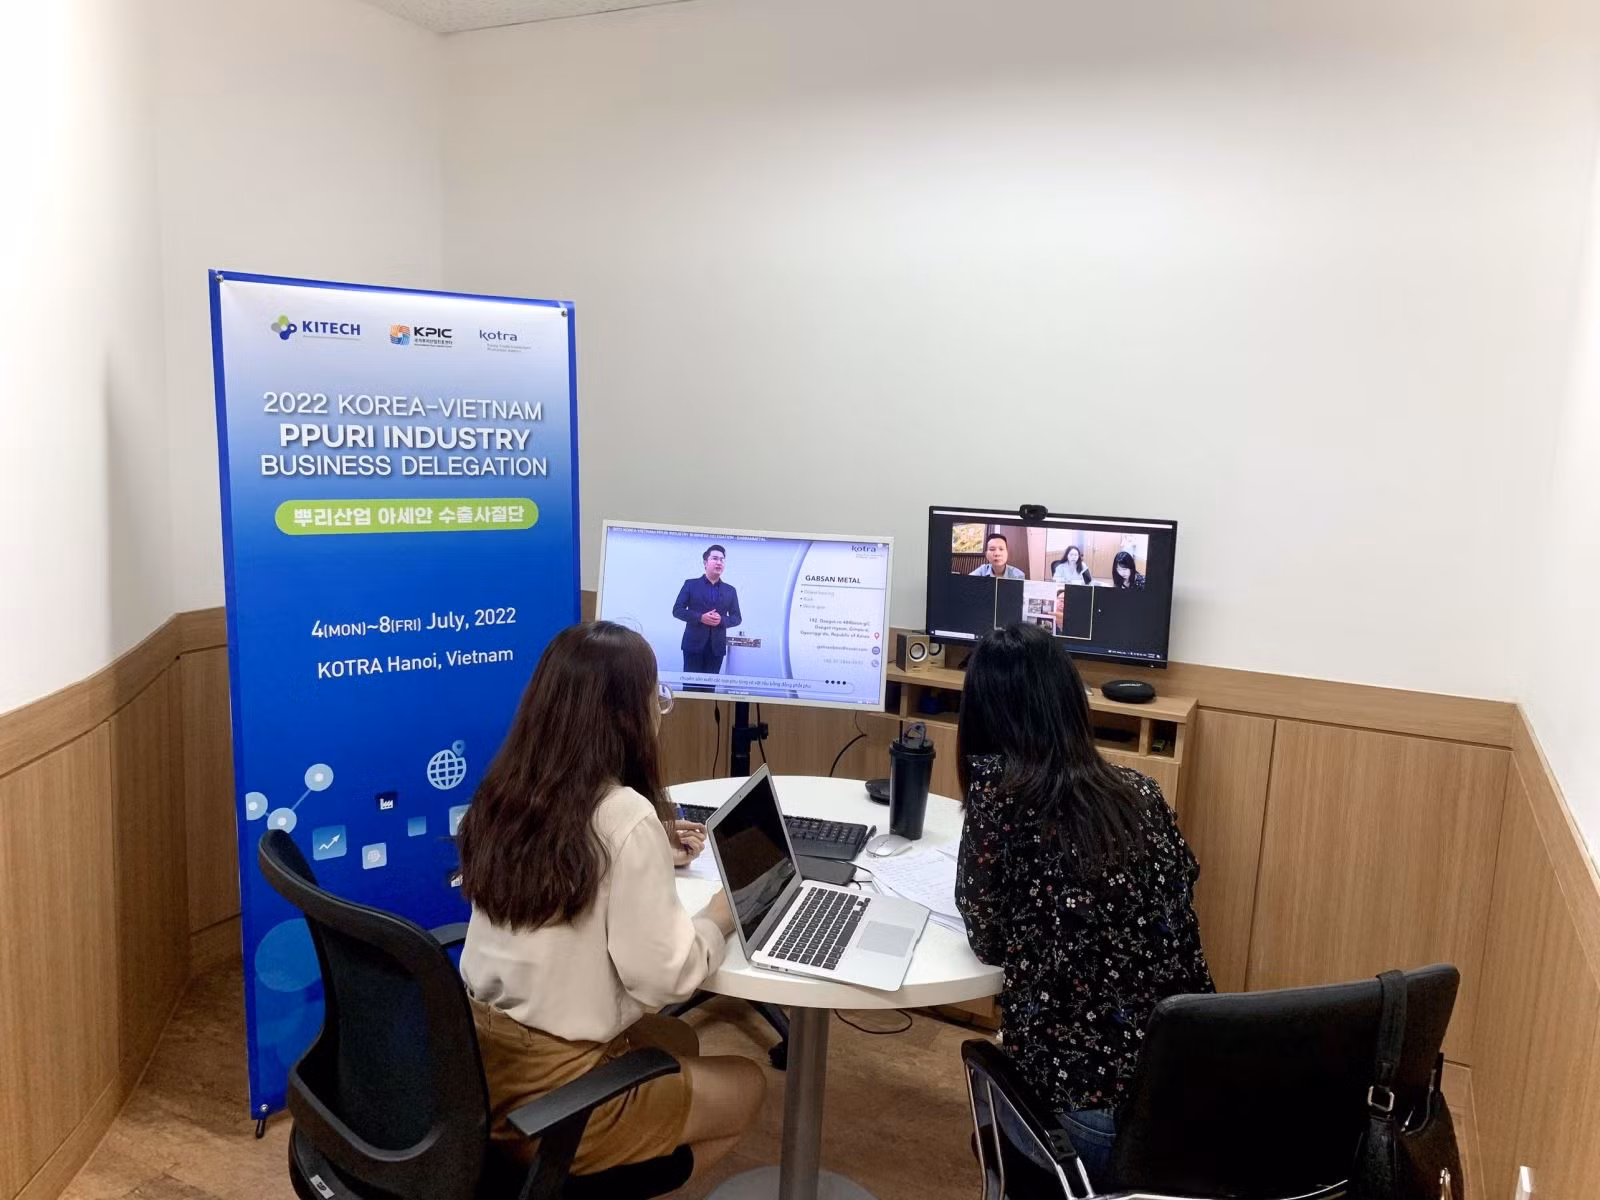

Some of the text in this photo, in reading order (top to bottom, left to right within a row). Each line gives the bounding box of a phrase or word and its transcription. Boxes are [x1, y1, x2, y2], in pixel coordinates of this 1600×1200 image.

[302, 320, 361, 336] KITECH
[413, 326, 453, 339] KPIC
[479, 329, 518, 342] kotra
[263, 392, 543, 421] 2022 KOREA-VIETNAM
[279, 423, 531, 450] PPURI INDUSTRY
[261, 454, 548, 477] BUSINESS DELEGATION
[293, 506, 525, 528] 뿌리산업 아세안 수출사절단
[851, 545, 877, 553] kotra
[805, 574, 862, 584] GABSAN METAL
[426, 611, 470, 632] July,
[474, 607, 517, 626] 2022
[317, 649, 514, 680] KOTRA Hanoi, Vietnam
